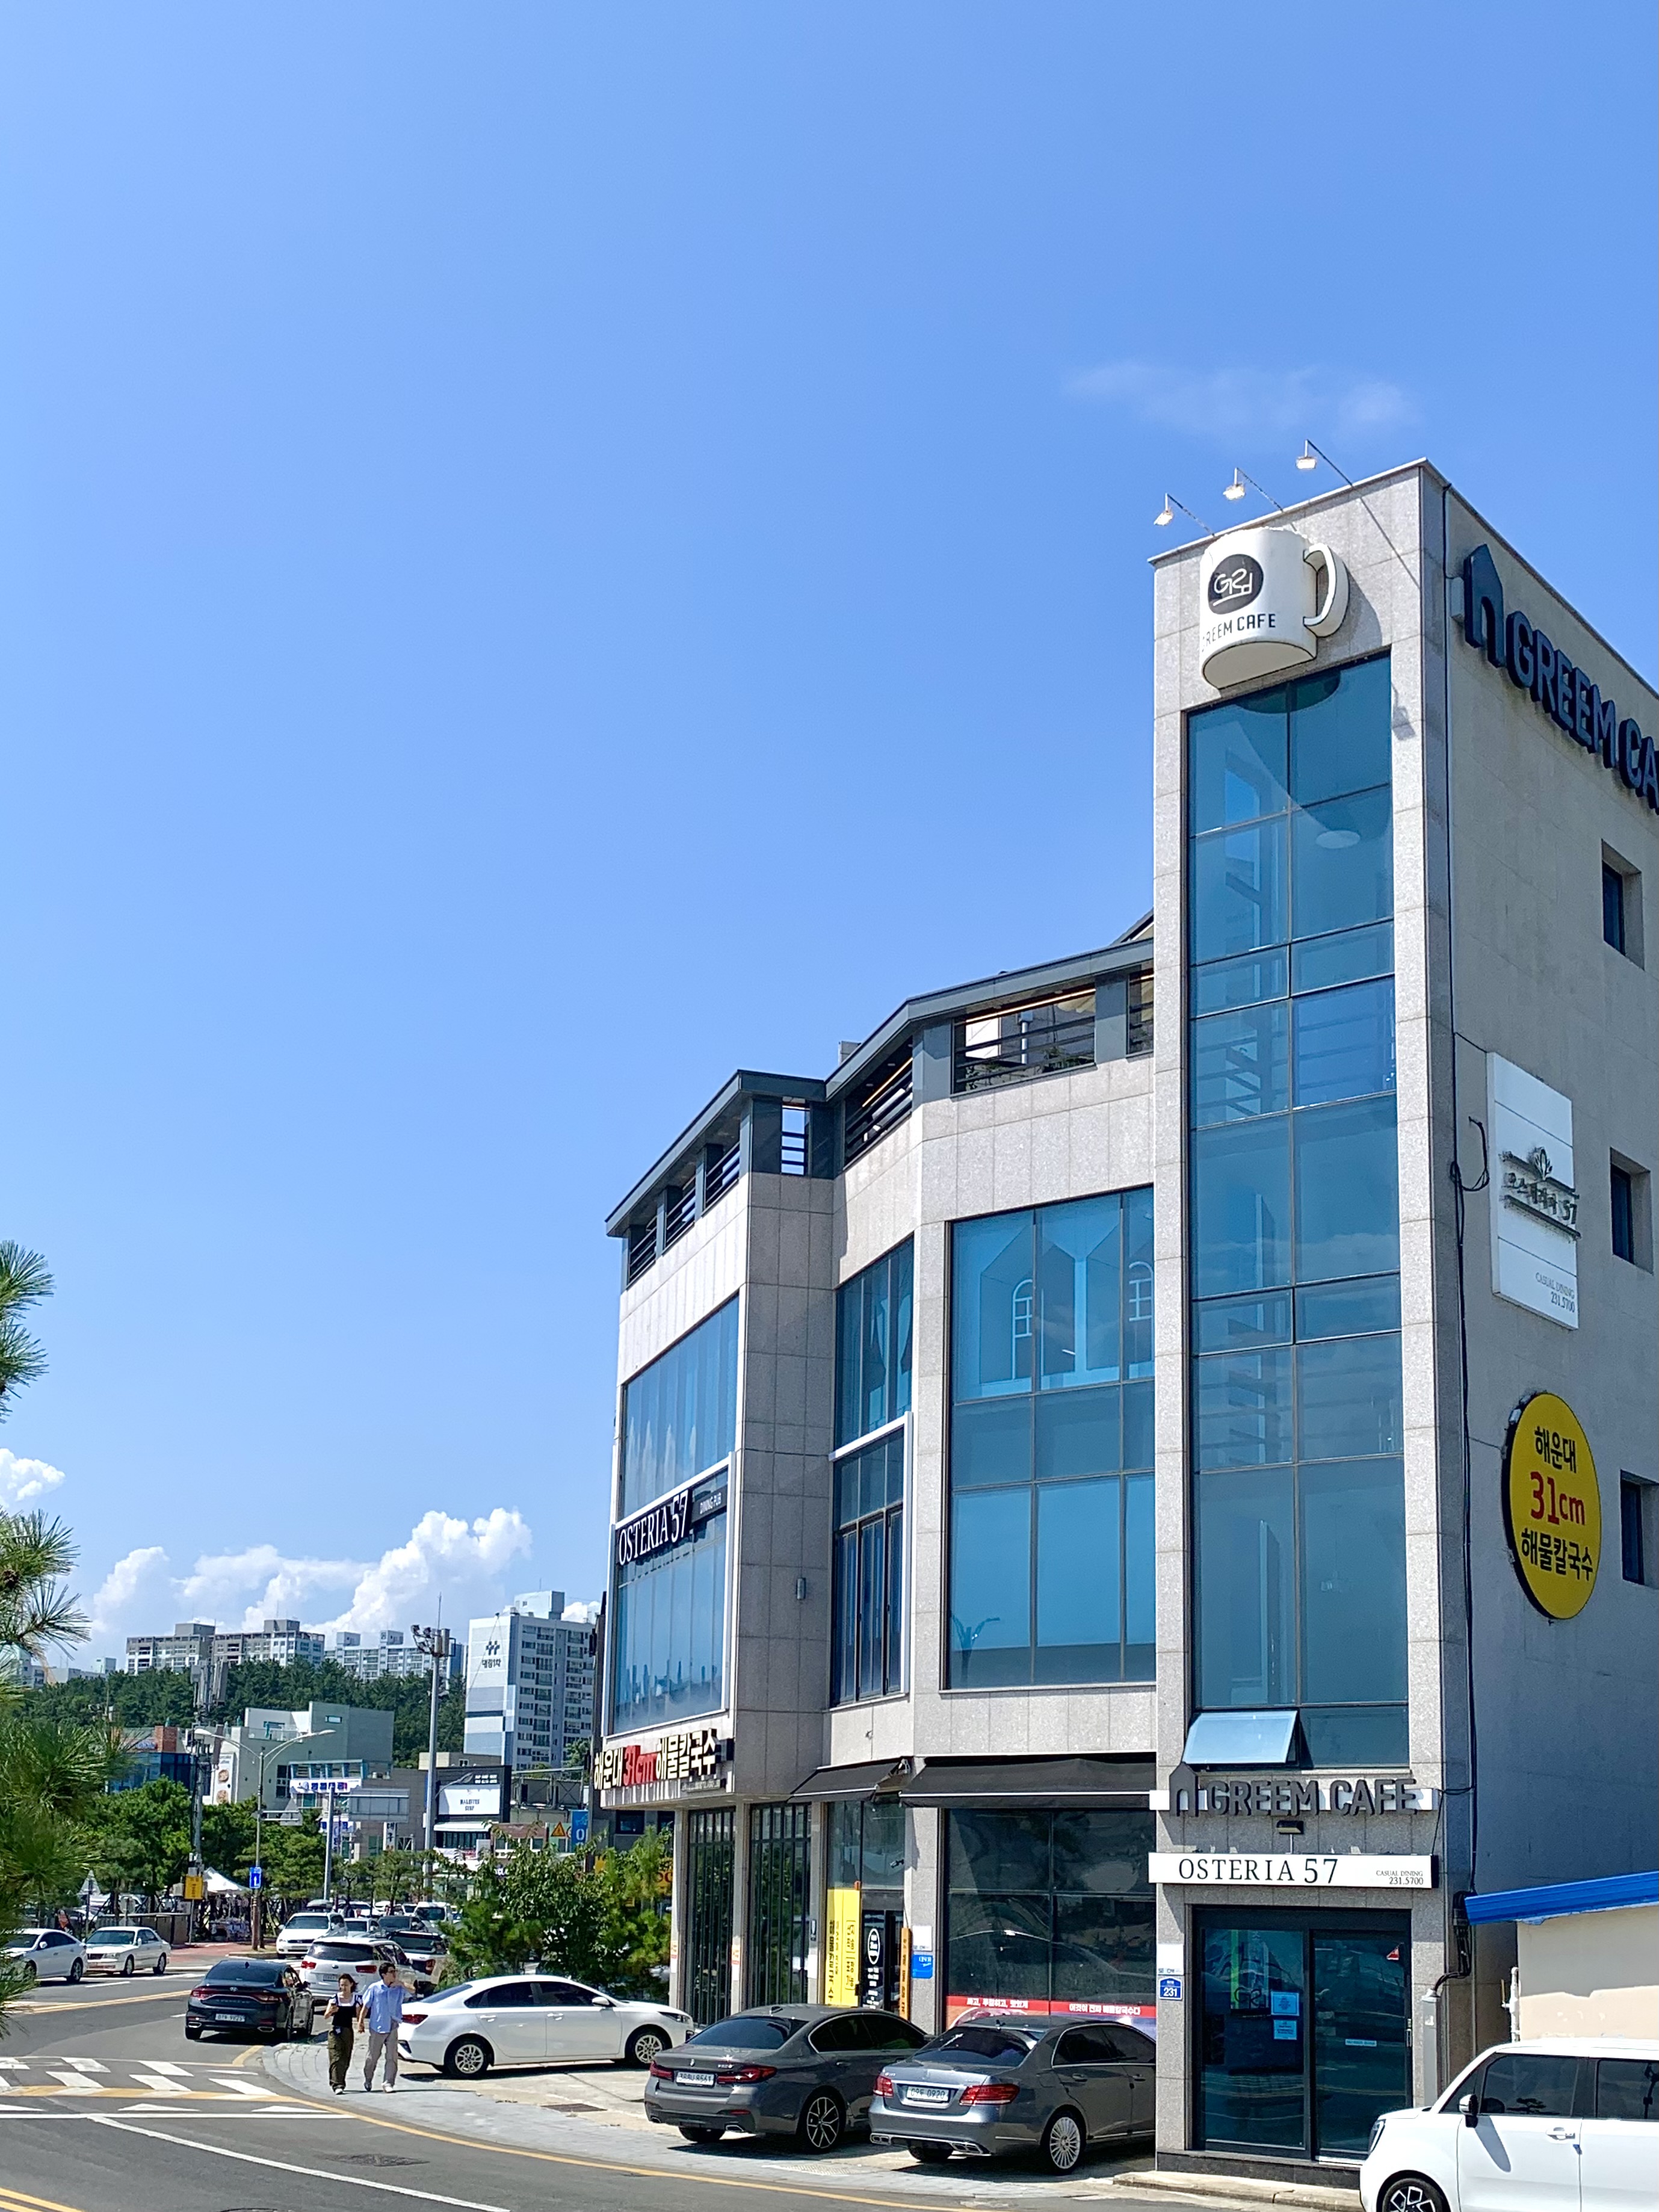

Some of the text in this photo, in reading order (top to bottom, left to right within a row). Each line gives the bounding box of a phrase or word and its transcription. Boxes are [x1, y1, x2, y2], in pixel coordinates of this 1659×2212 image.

[1237, 613, 1276, 631] CAFE
[1506, 610, 1659, 816] GREEM CA
[1534, 1426, 1577, 1474] 해운대
[1530, 1471, 1586, 1526] 31cm
[619, 1489, 689, 1566] OSTERIA 57
[1521, 1528, 1594, 1581] 해물칼국수
[593, 1728, 717, 1791] 해운대 31cm 해물칼국수
[1207, 1778, 1418, 1816] GREEM CAFE
[1178, 1858, 1339, 1884] OSTERIA 57
[1389, 1876, 1424, 1885] 231.5700
[1163, 1987, 1178, 1997] 231
